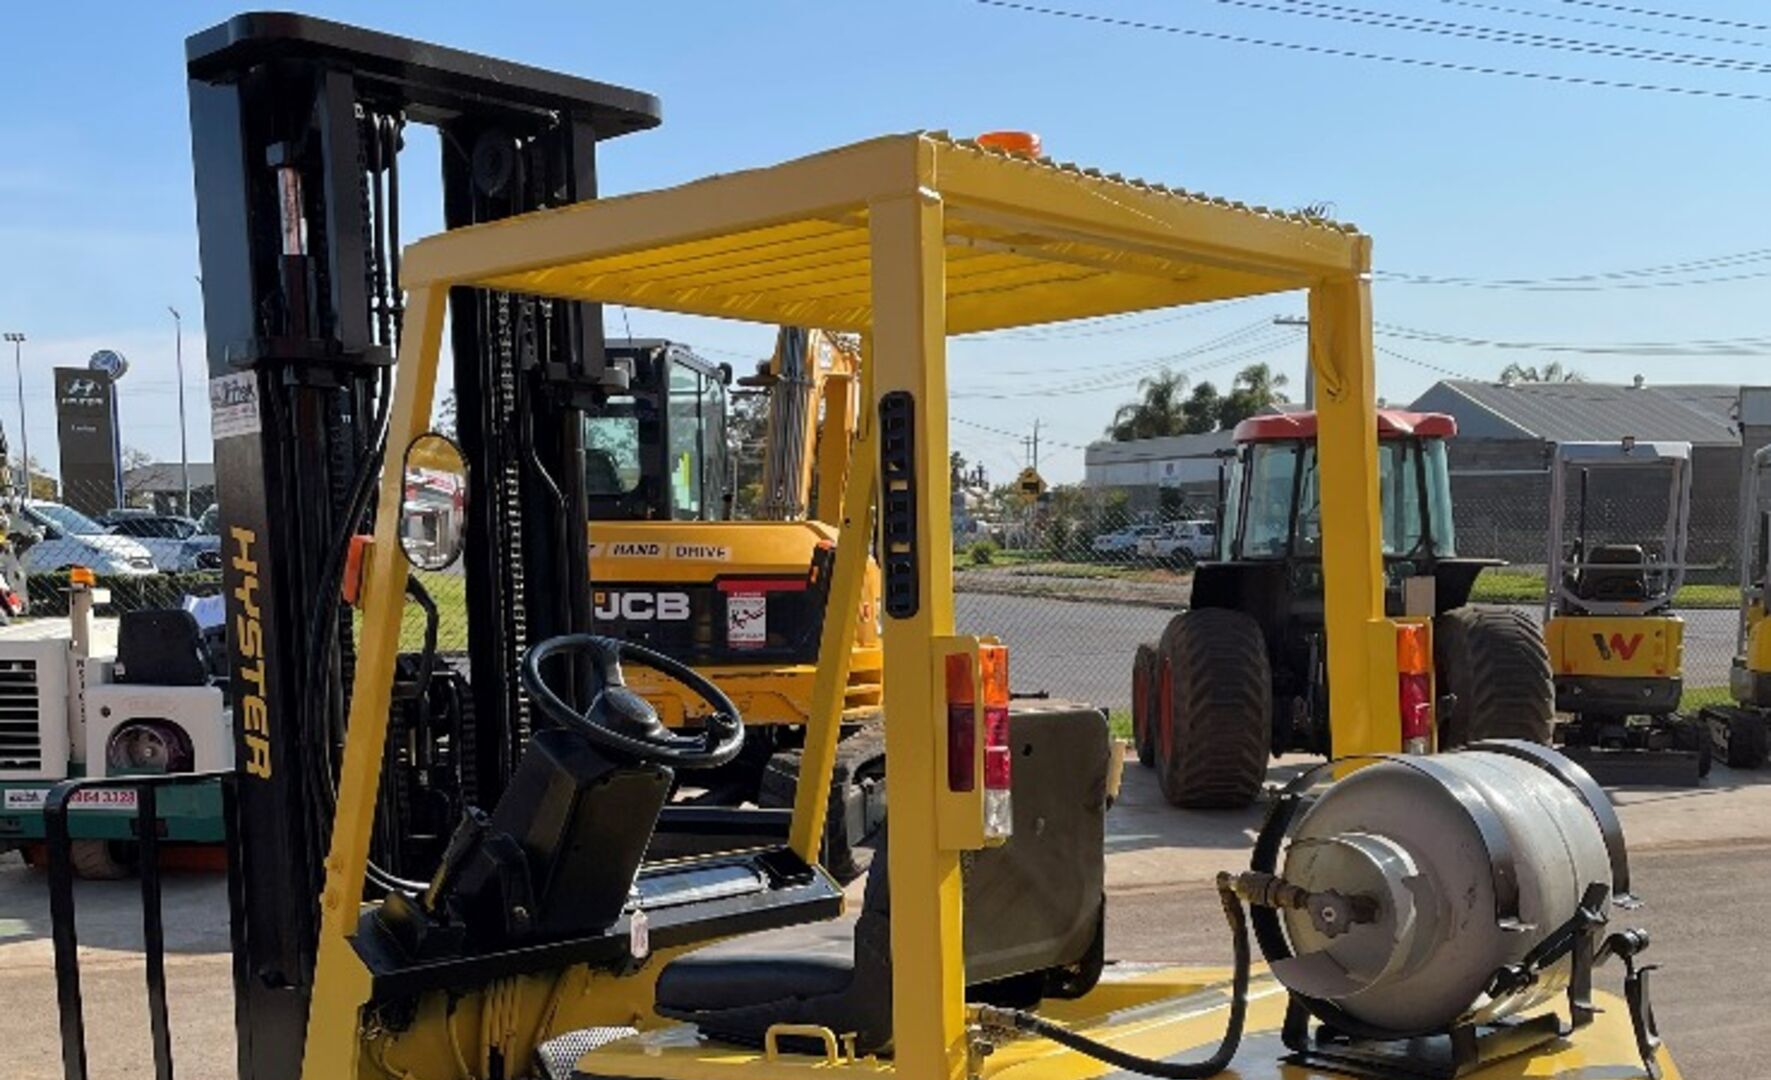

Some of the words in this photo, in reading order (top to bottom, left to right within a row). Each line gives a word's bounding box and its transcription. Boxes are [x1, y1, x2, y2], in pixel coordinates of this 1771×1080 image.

[614, 544, 661, 556] HAND
[595, 592, 690, 620] JCB
[230, 526, 272, 780] HYSTER
